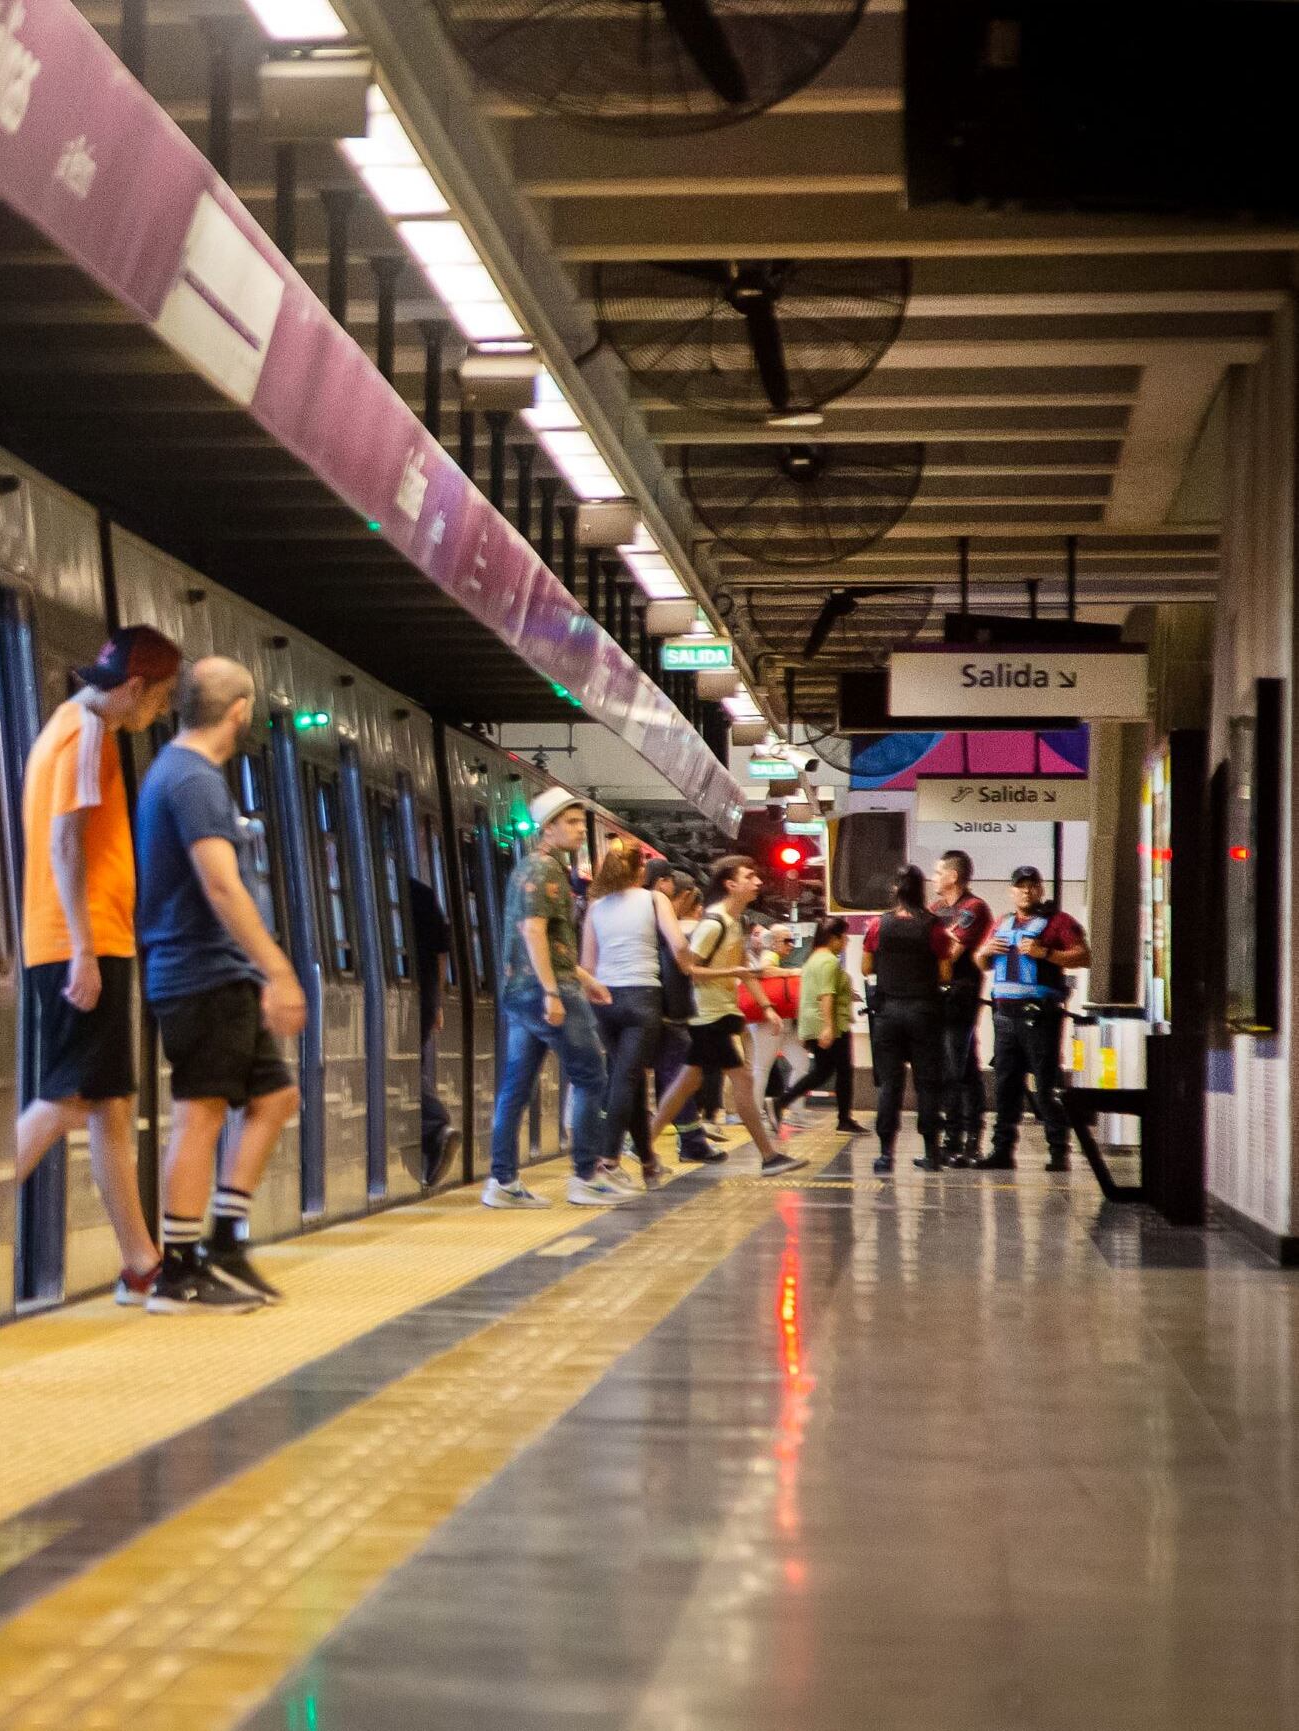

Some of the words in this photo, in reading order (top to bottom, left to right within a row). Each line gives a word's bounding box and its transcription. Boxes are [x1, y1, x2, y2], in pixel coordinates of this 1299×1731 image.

[667, 647, 728, 664] SALIDA
[961, 663, 1049, 688] Salida
[978, 785, 1038, 803] Salida
